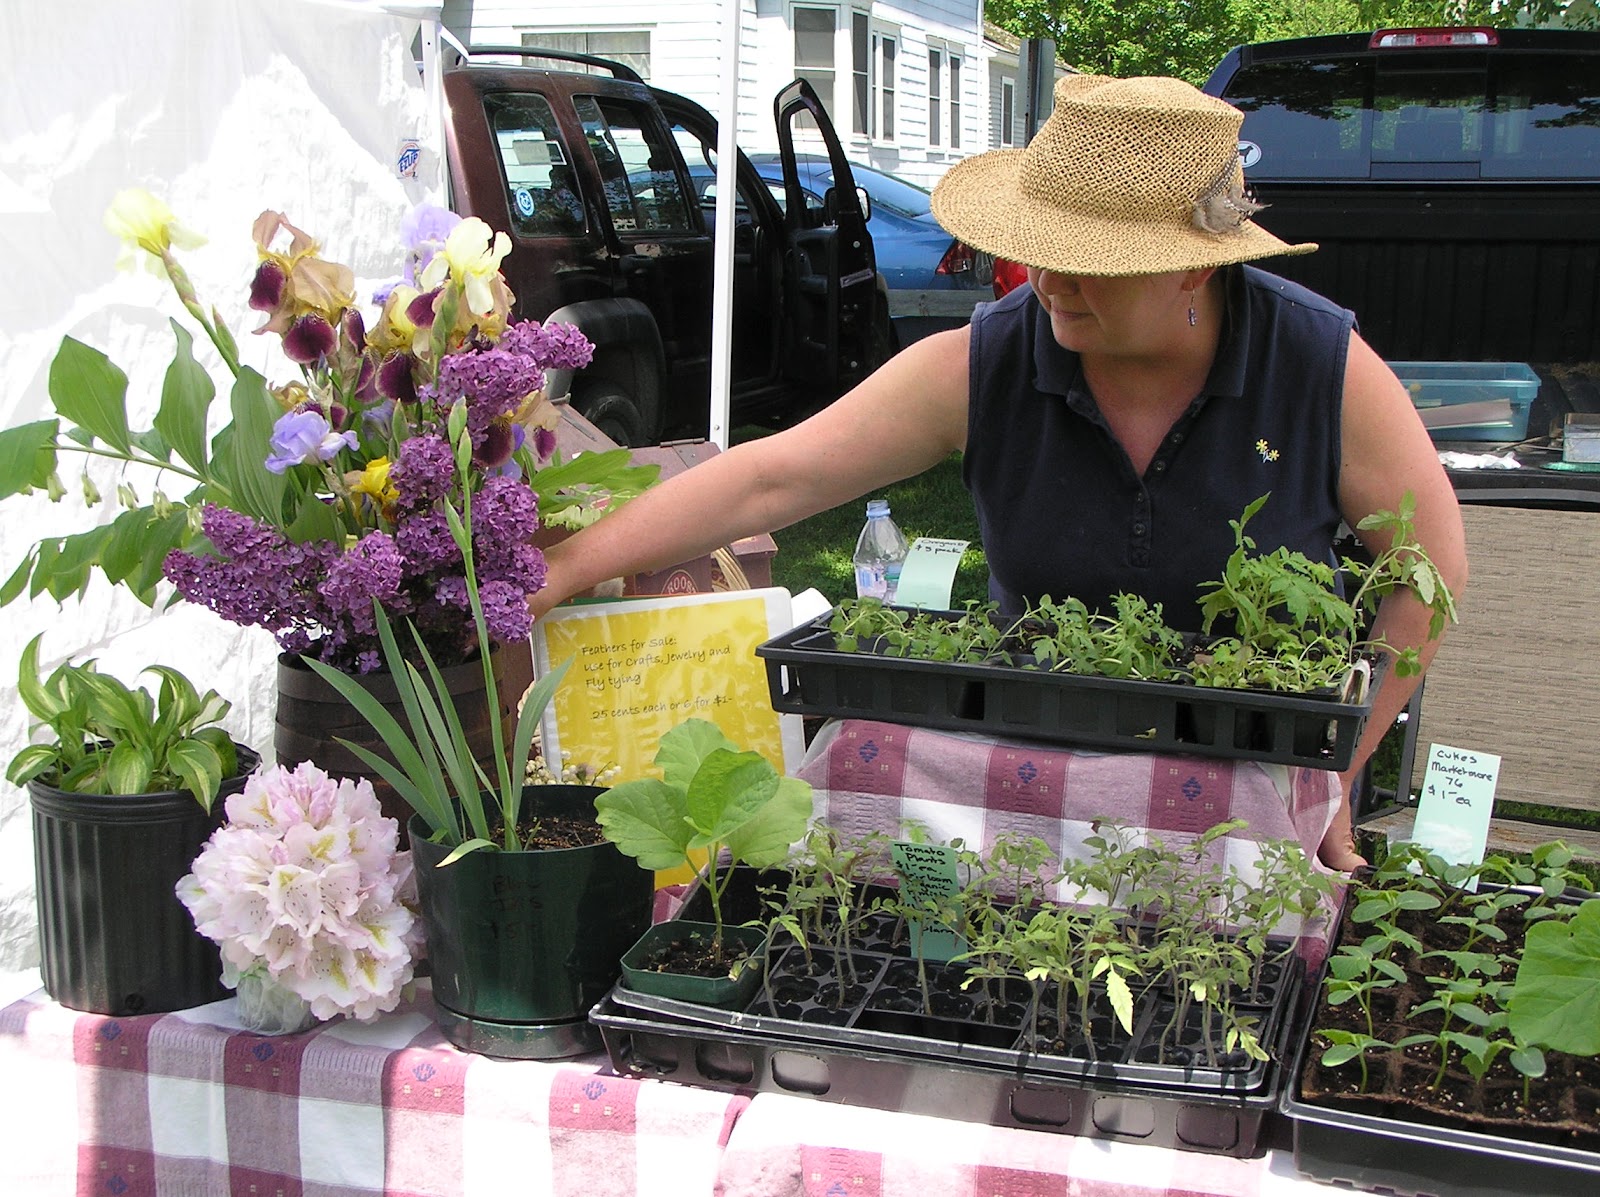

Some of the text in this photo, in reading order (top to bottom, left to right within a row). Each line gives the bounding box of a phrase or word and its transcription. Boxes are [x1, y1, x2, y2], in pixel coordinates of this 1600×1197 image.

[582, 636, 677, 656] Feathers for Sale:
[607, 658, 622, 672] for
[626, 654, 664, 667] Crafts,
[663, 650, 706, 665] Jewelry
[709, 645, 730, 656] and
[585, 674, 641, 691] Fly tying
[611, 706, 640, 718] cents
[643, 701, 666, 713] each
[670, 702, 681, 710] or
[694, 696, 710, 709] for
[1445, 776, 1463, 788] 76
[894, 843, 946, 856] Tomato
